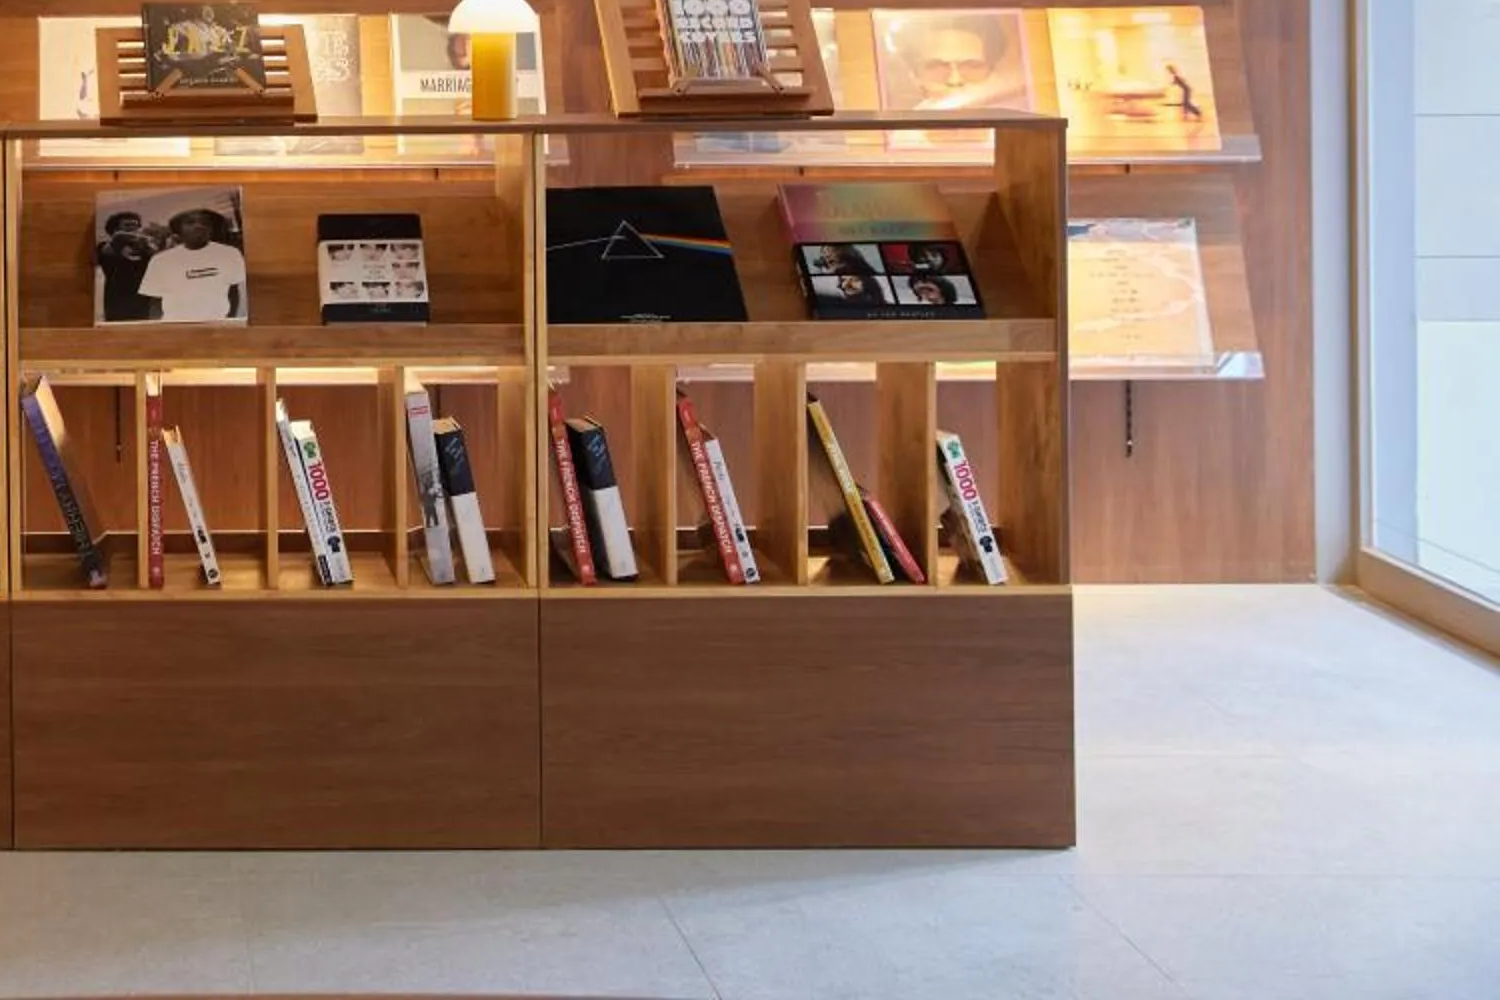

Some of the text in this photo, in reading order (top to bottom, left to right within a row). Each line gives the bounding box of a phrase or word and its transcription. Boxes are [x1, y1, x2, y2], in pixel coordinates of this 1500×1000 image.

[150, 440, 161, 555] THE FRENCH DISPATCH
[307, 461, 331, 501] 1000
[952, 460, 977, 501] 1000
